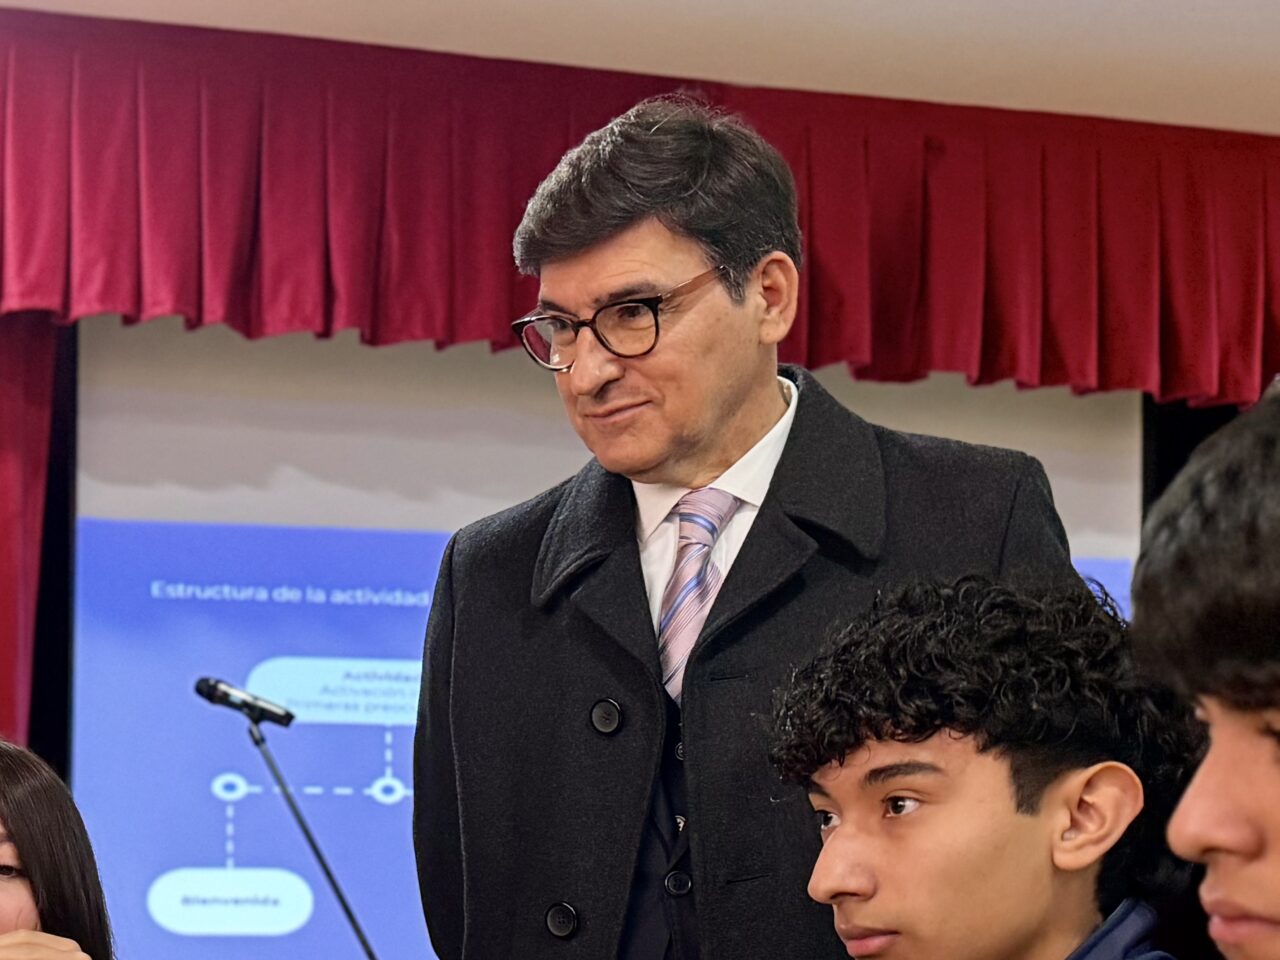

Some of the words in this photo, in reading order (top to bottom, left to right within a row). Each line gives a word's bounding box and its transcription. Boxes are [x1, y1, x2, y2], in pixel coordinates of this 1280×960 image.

[150, 580, 268, 602] Estructura
[272, 585, 302, 602] de
[306, 585, 327, 604] la
[330, 587, 430, 607] actividad
